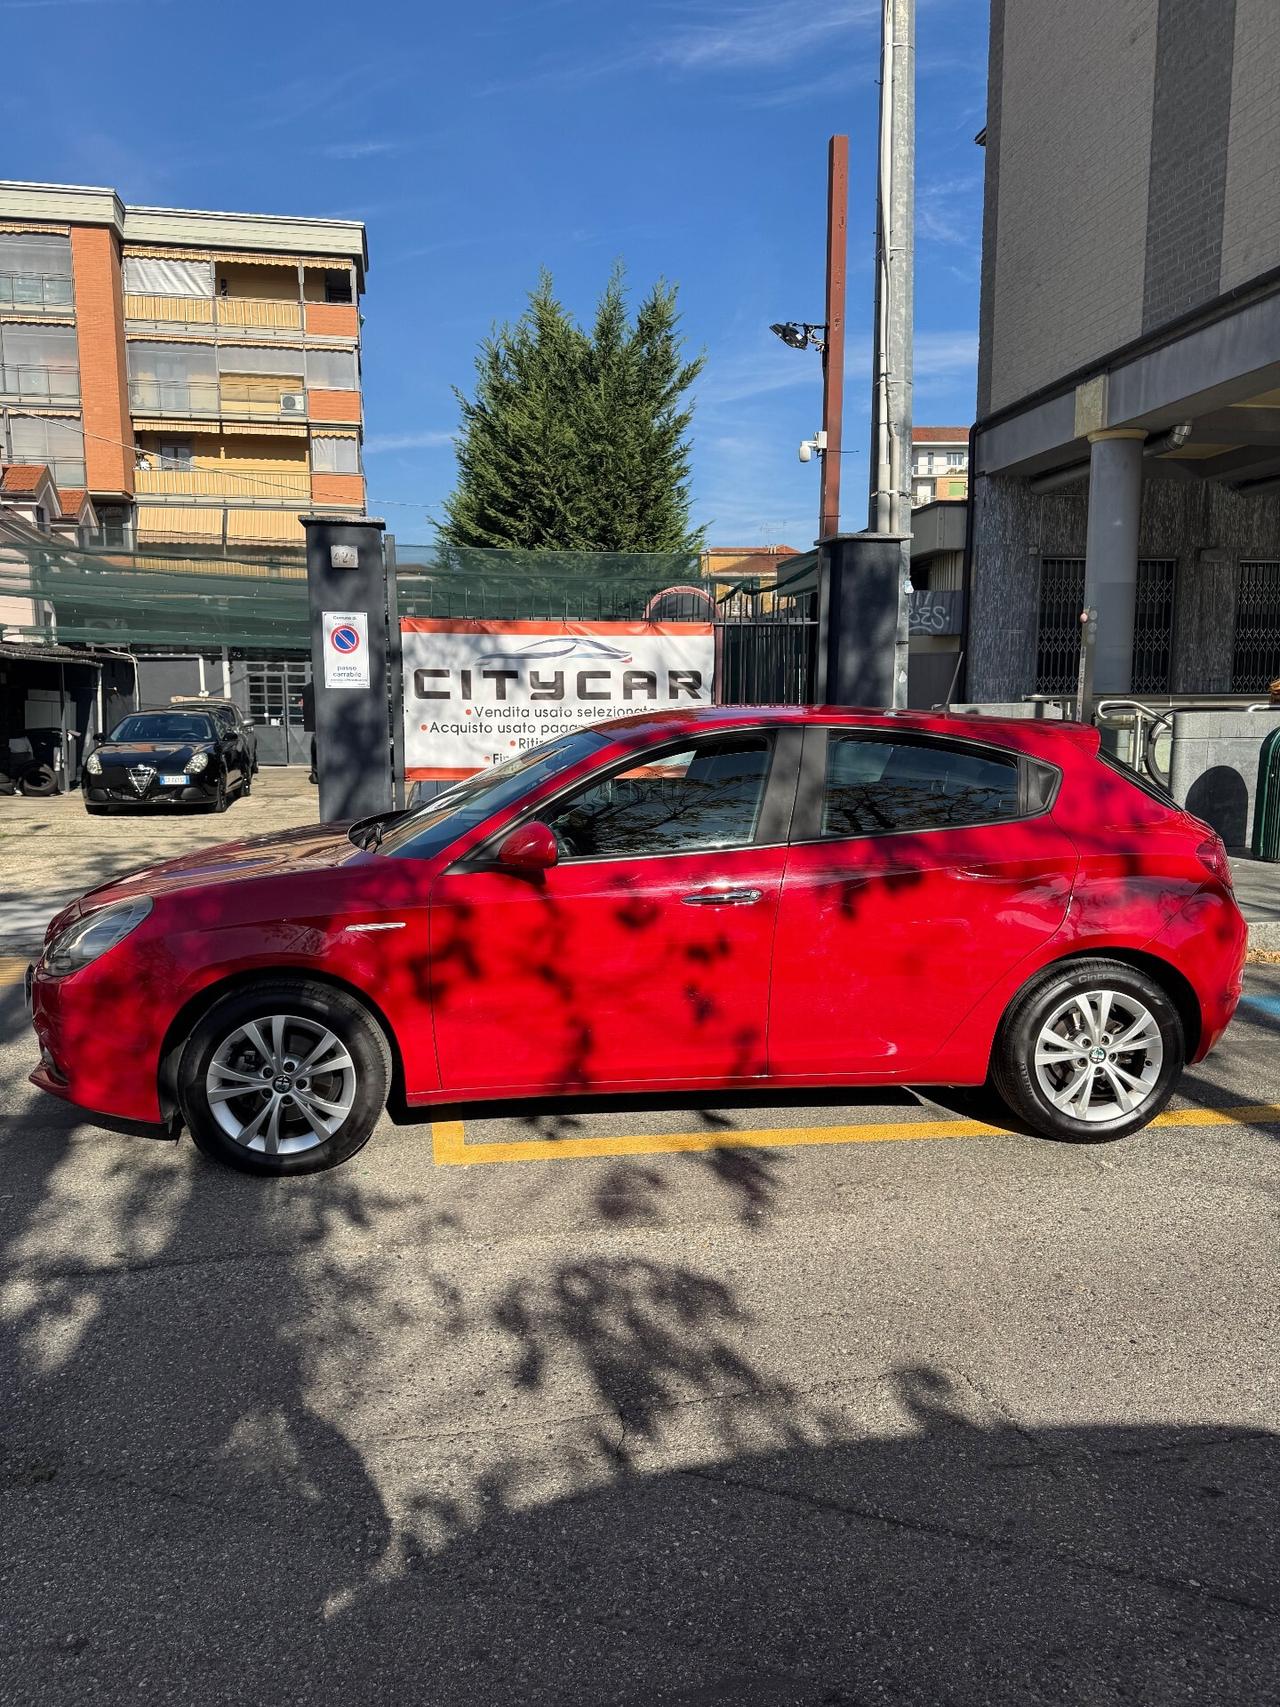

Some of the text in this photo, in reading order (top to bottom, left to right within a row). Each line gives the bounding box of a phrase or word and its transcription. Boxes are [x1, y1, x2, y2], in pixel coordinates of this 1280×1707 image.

[413, 668, 703, 701] CITYCAR
[474, 706, 530, 718] Vendita
[534, 707, 573, 718] usato
[429, 721, 581, 736] Acquisto usato paga
